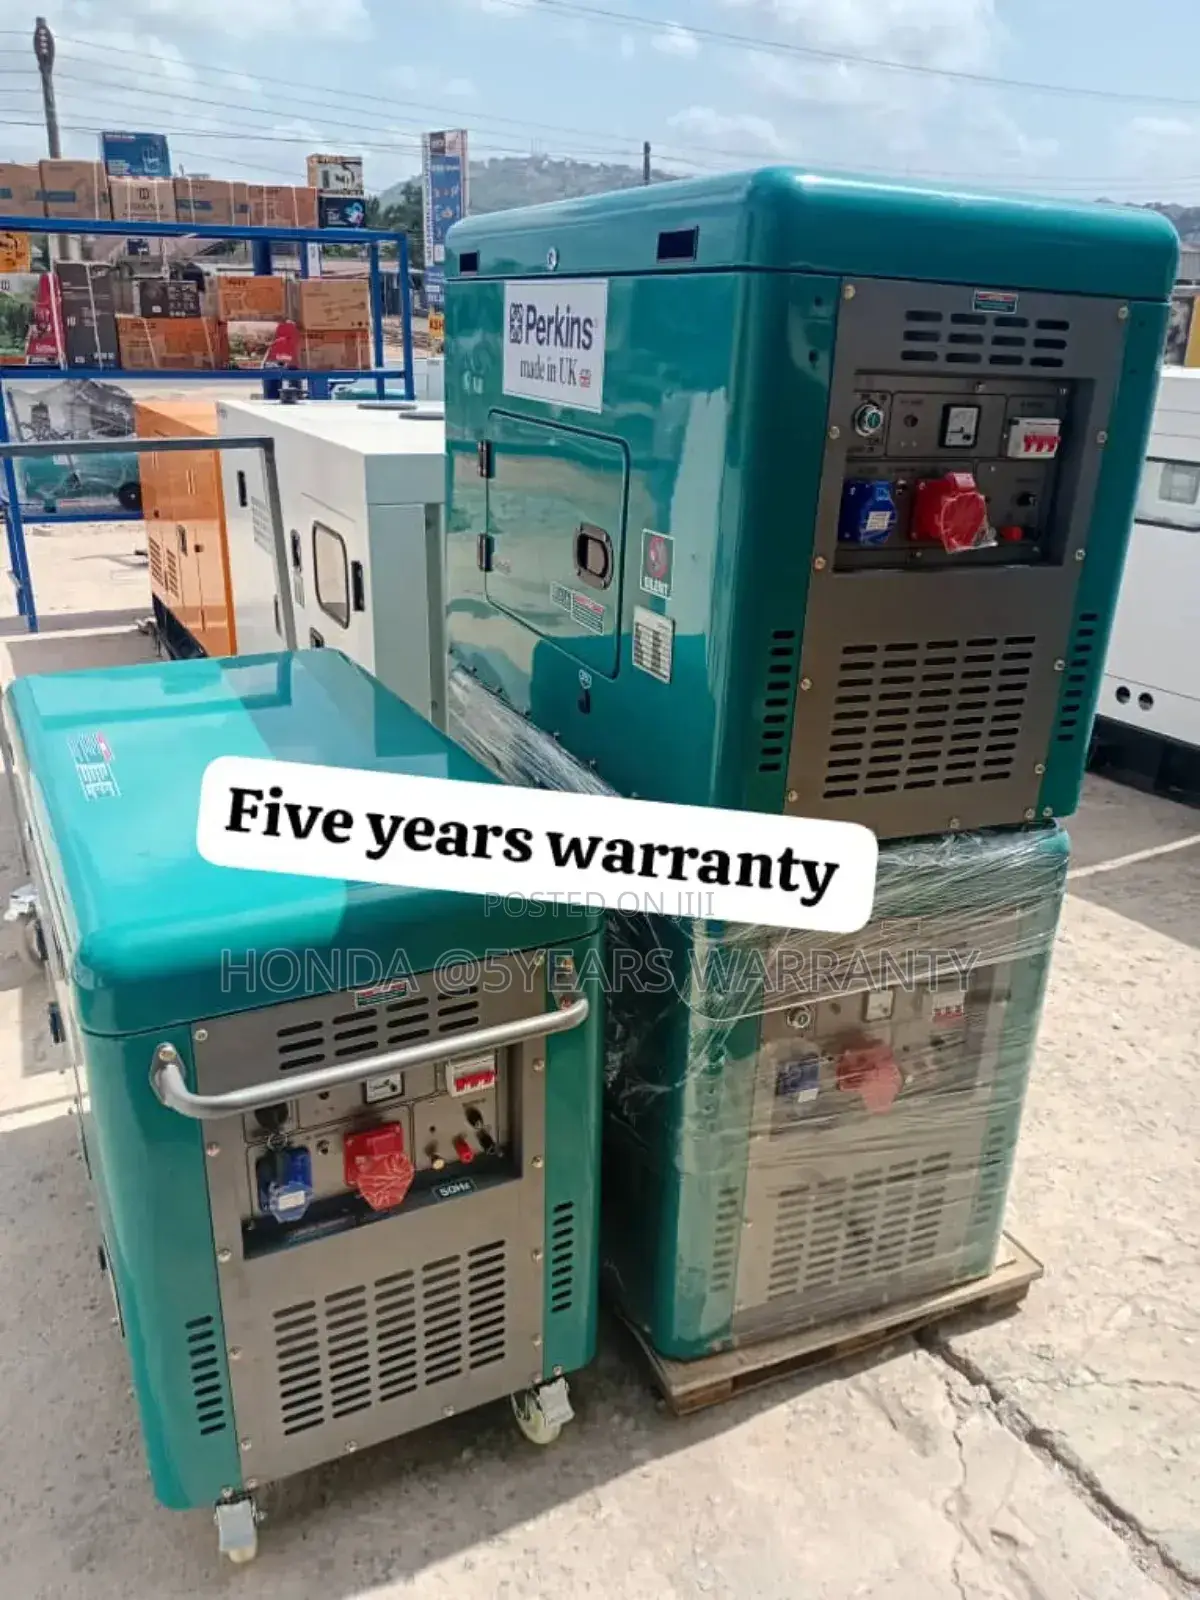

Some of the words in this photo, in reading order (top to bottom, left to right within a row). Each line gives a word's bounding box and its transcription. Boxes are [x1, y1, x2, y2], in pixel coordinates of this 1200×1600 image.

[526, 304, 594, 350] Perkins
[520, 354, 545, 380] made
[547, 356, 556, 382] in
[560, 357, 578, 386] UK
